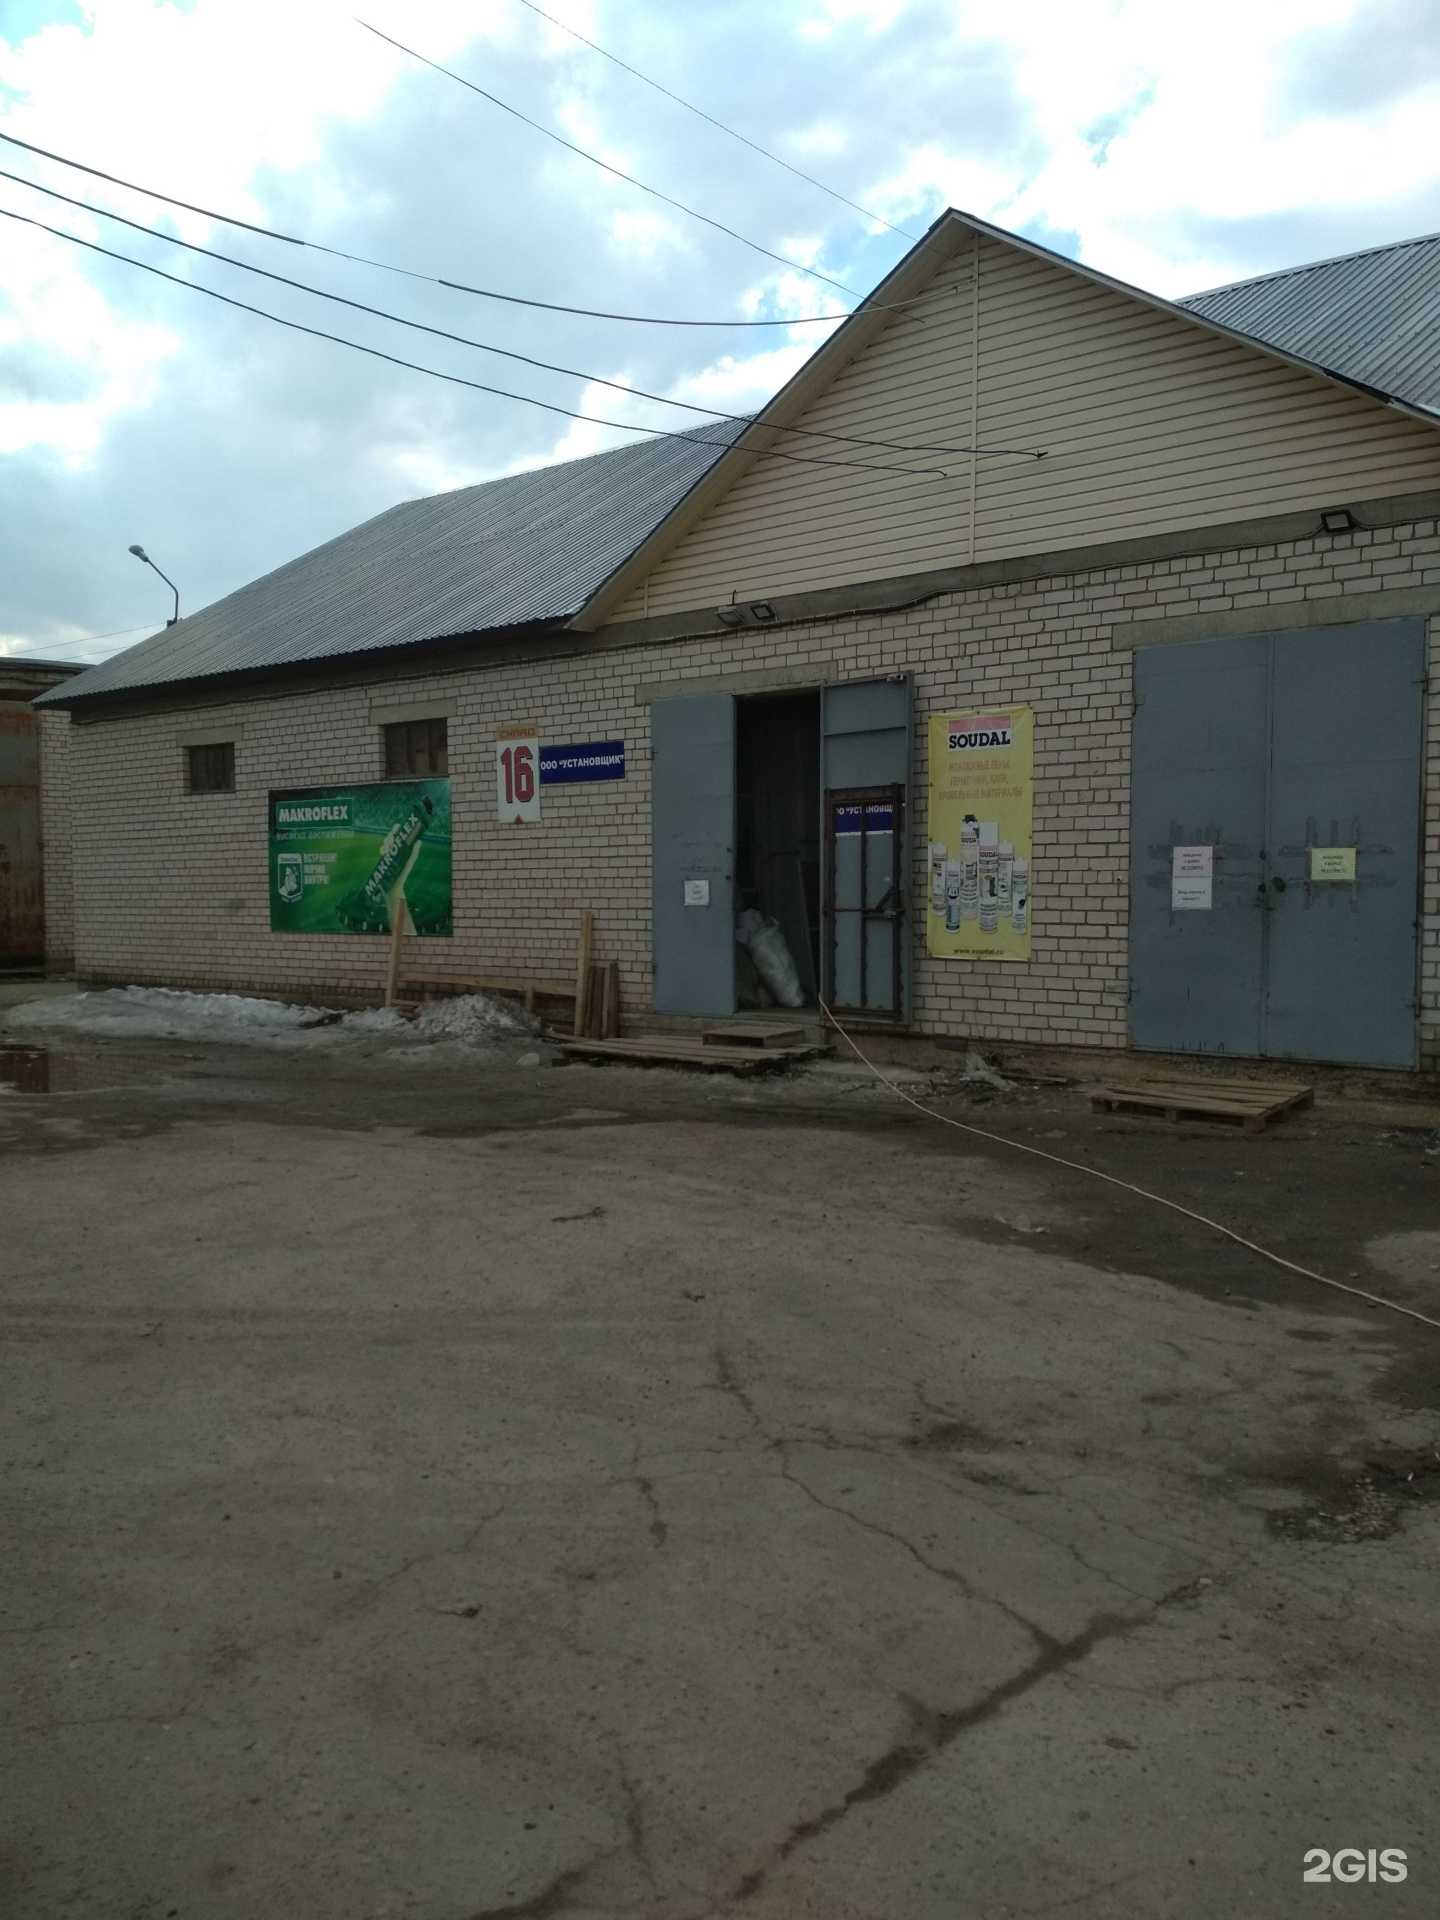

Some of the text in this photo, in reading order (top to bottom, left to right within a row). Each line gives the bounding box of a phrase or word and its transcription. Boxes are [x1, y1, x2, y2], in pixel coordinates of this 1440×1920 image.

[949, 731, 1011, 749] SOUDAL
[540, 754, 625, 770] ООО "УСТАНОВЩИК"
[501, 745, 534, 804] 16
[279, 805, 348, 822] MAKROFLEX
[364, 813, 419, 896] MAKROFLEX
